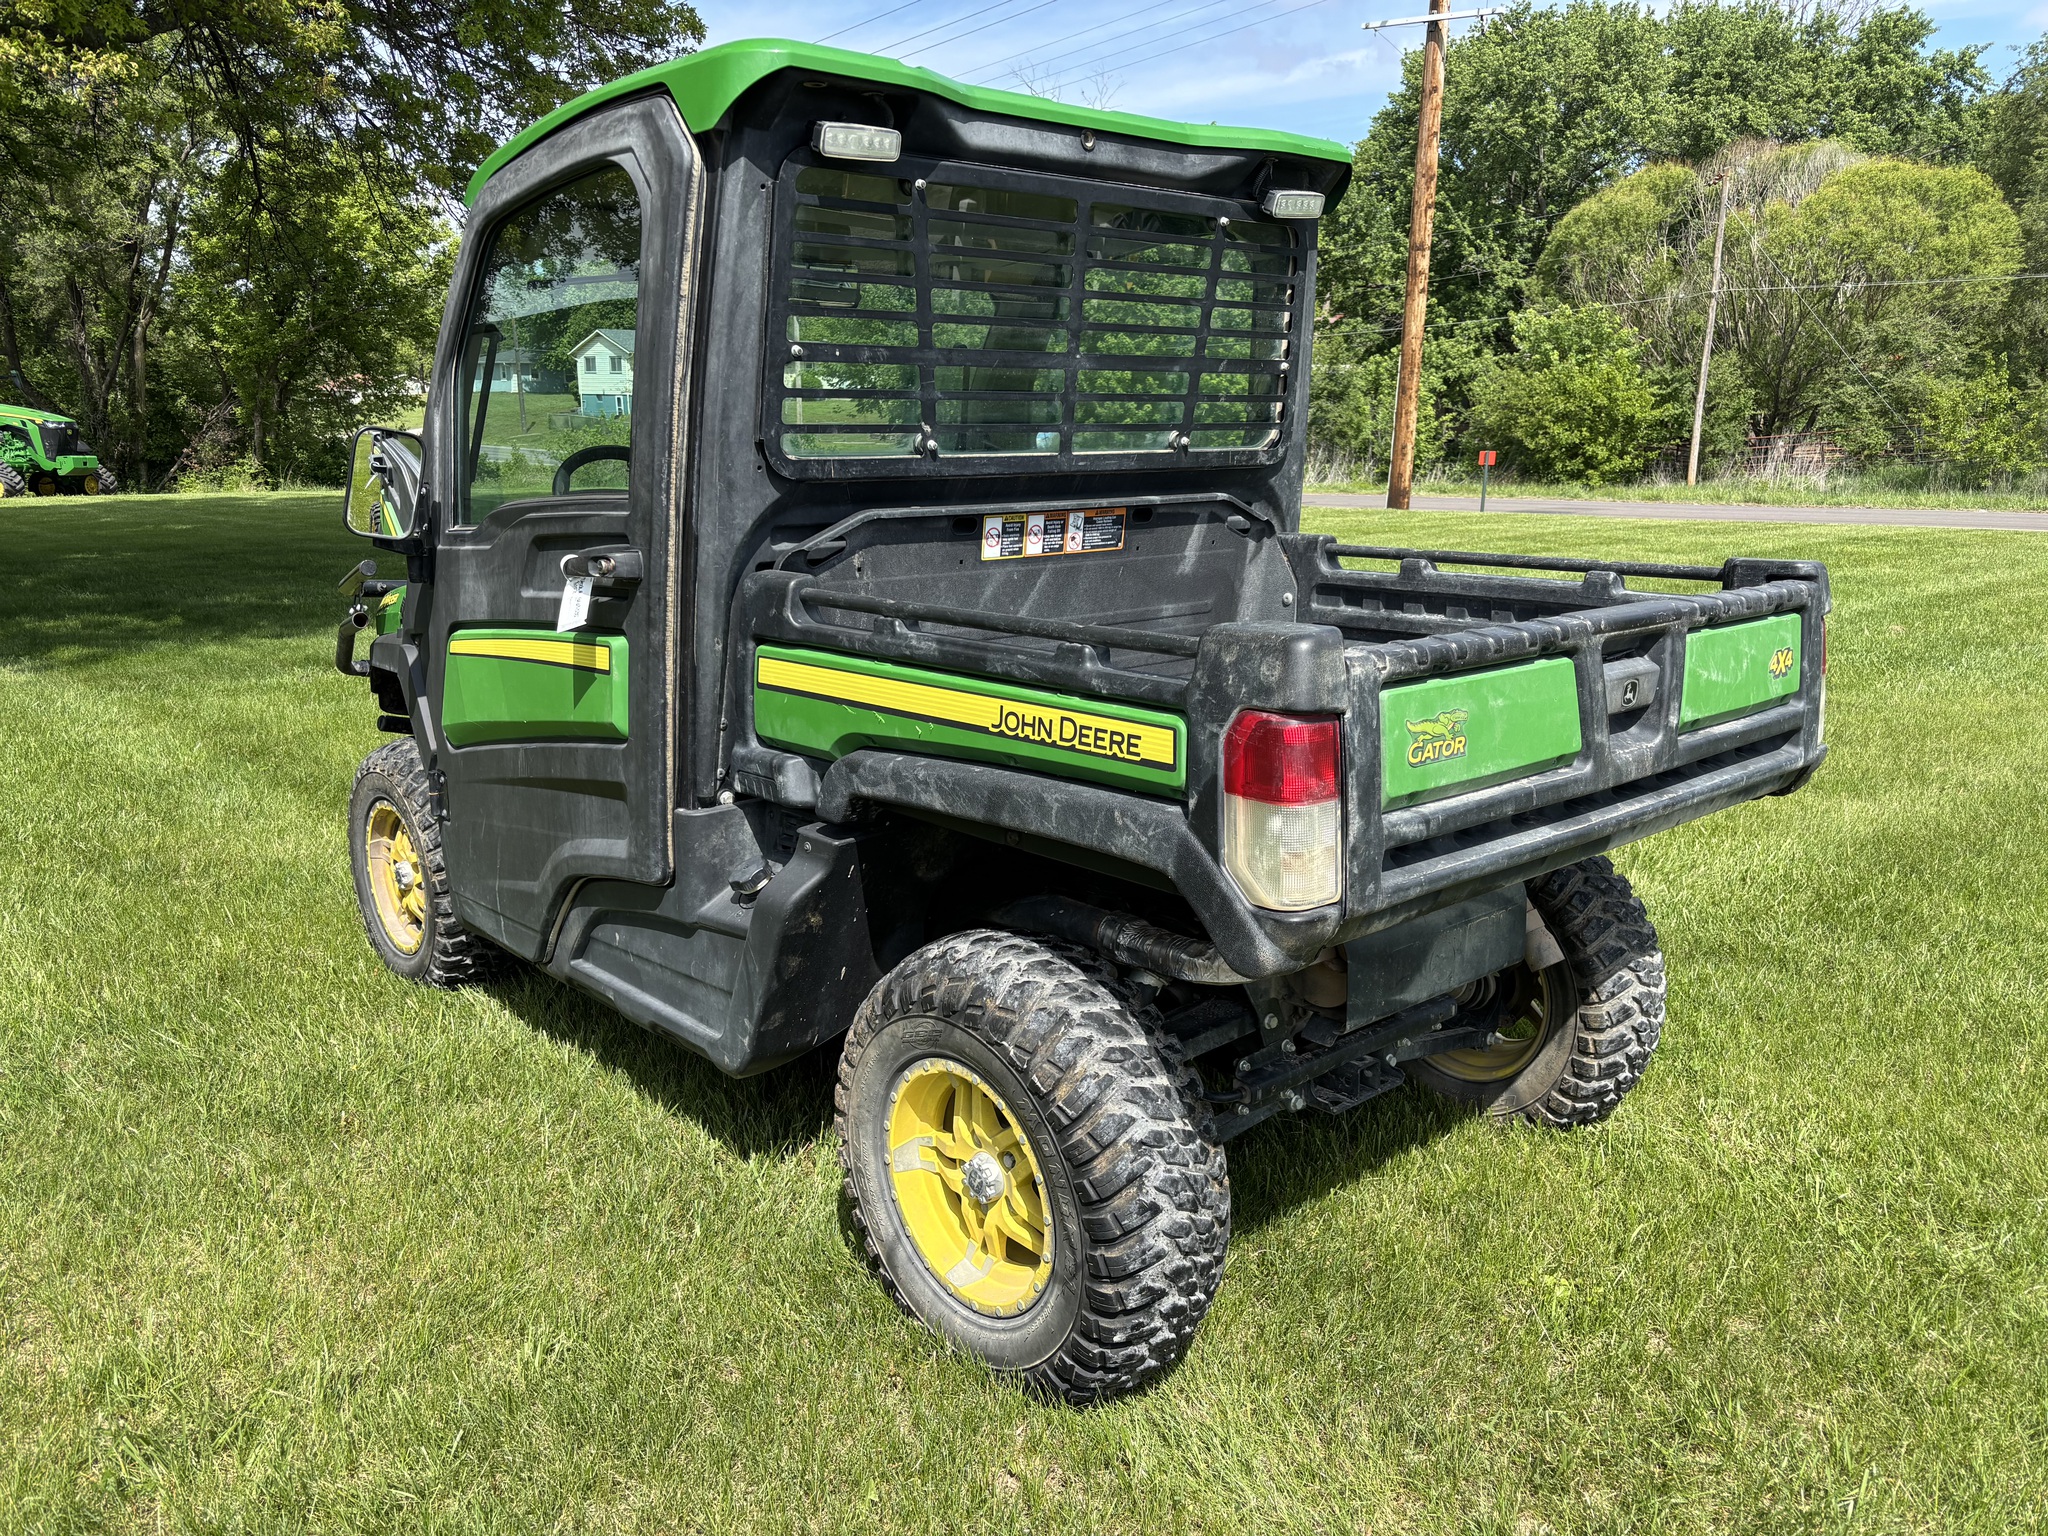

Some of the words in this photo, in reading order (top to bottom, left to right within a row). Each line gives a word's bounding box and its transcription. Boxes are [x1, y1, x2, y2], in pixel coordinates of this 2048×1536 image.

[1769, 648, 1793, 677] 4X4
[991, 704, 1053, 740] JOHN
[1059, 715, 1142, 758] DEERE
[1408, 736, 1466, 764] GATOR
